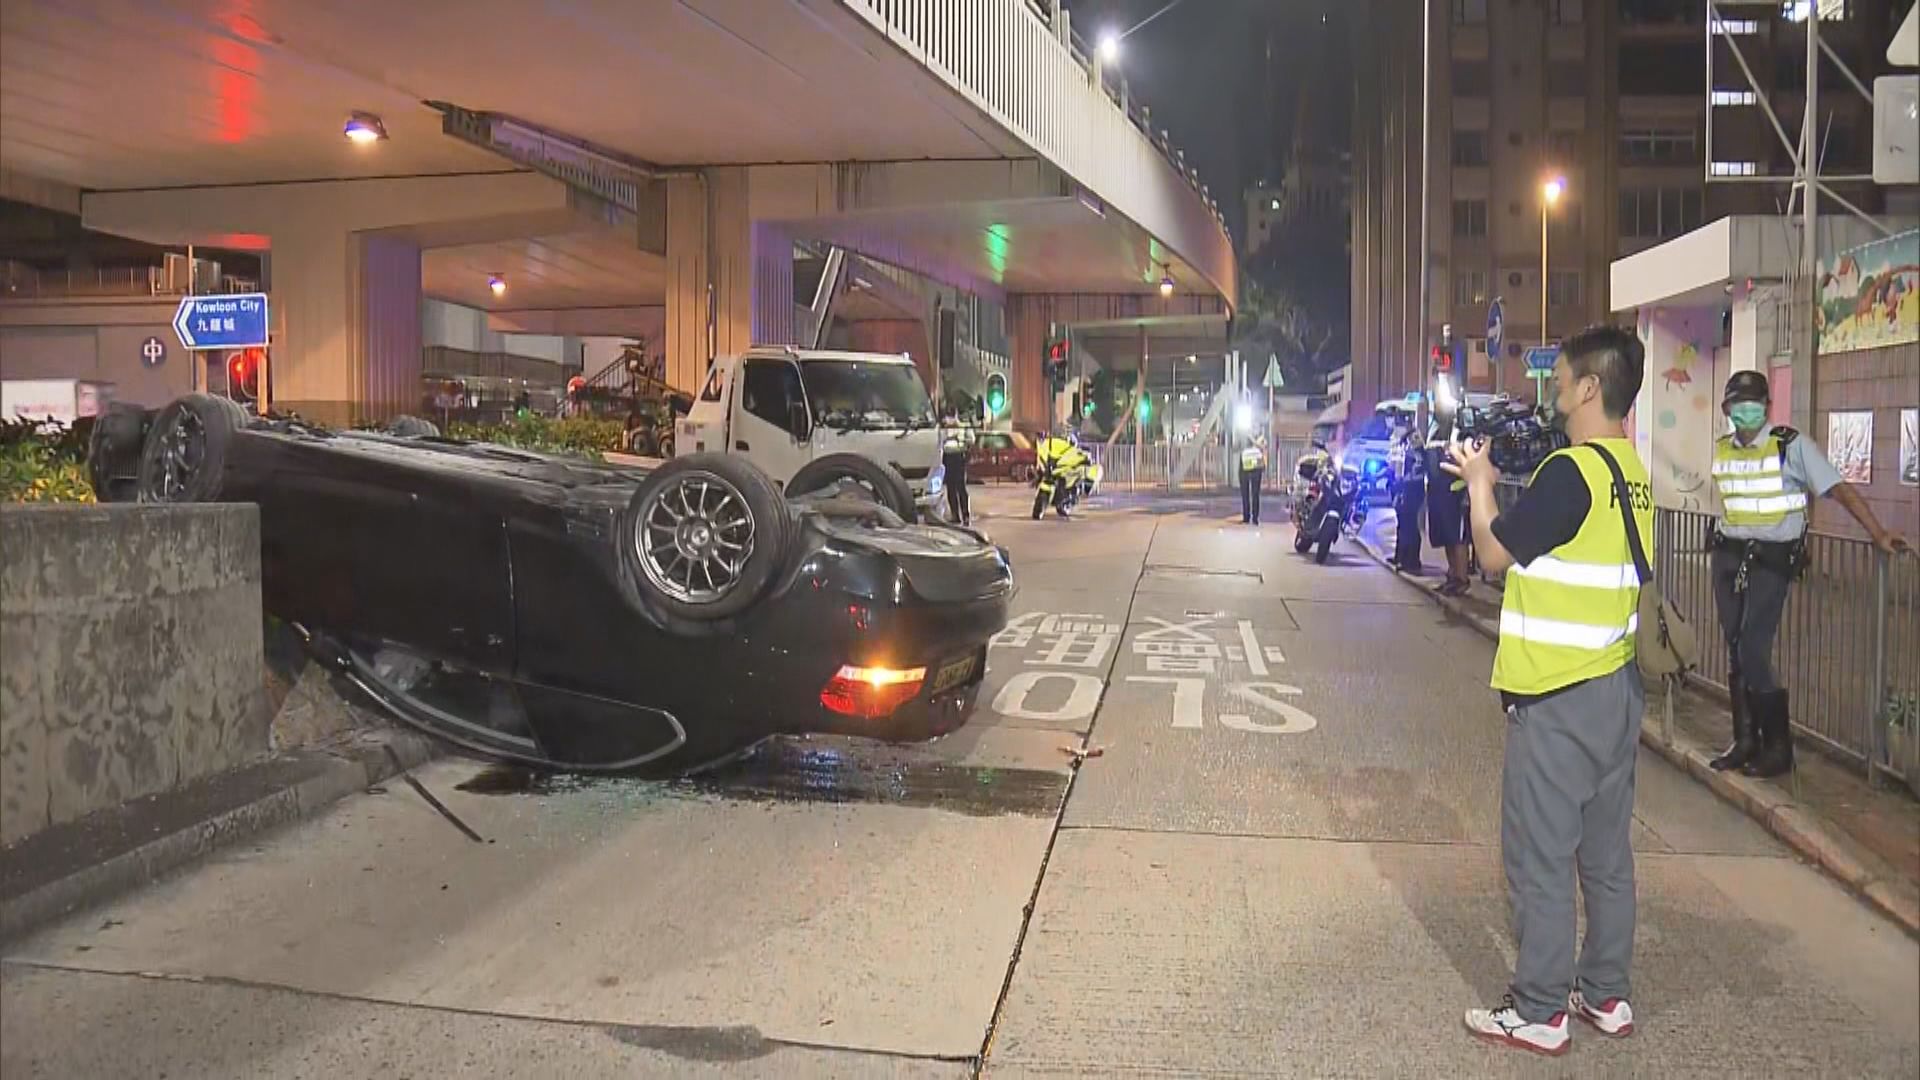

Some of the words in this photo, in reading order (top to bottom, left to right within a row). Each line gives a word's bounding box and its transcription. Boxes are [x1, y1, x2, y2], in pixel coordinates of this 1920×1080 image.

[196, 301, 237, 314] Kowloon
[240, 300, 260, 313] City
[1610, 481, 1653, 511] PRES
[992, 671, 1317, 733] SLO
